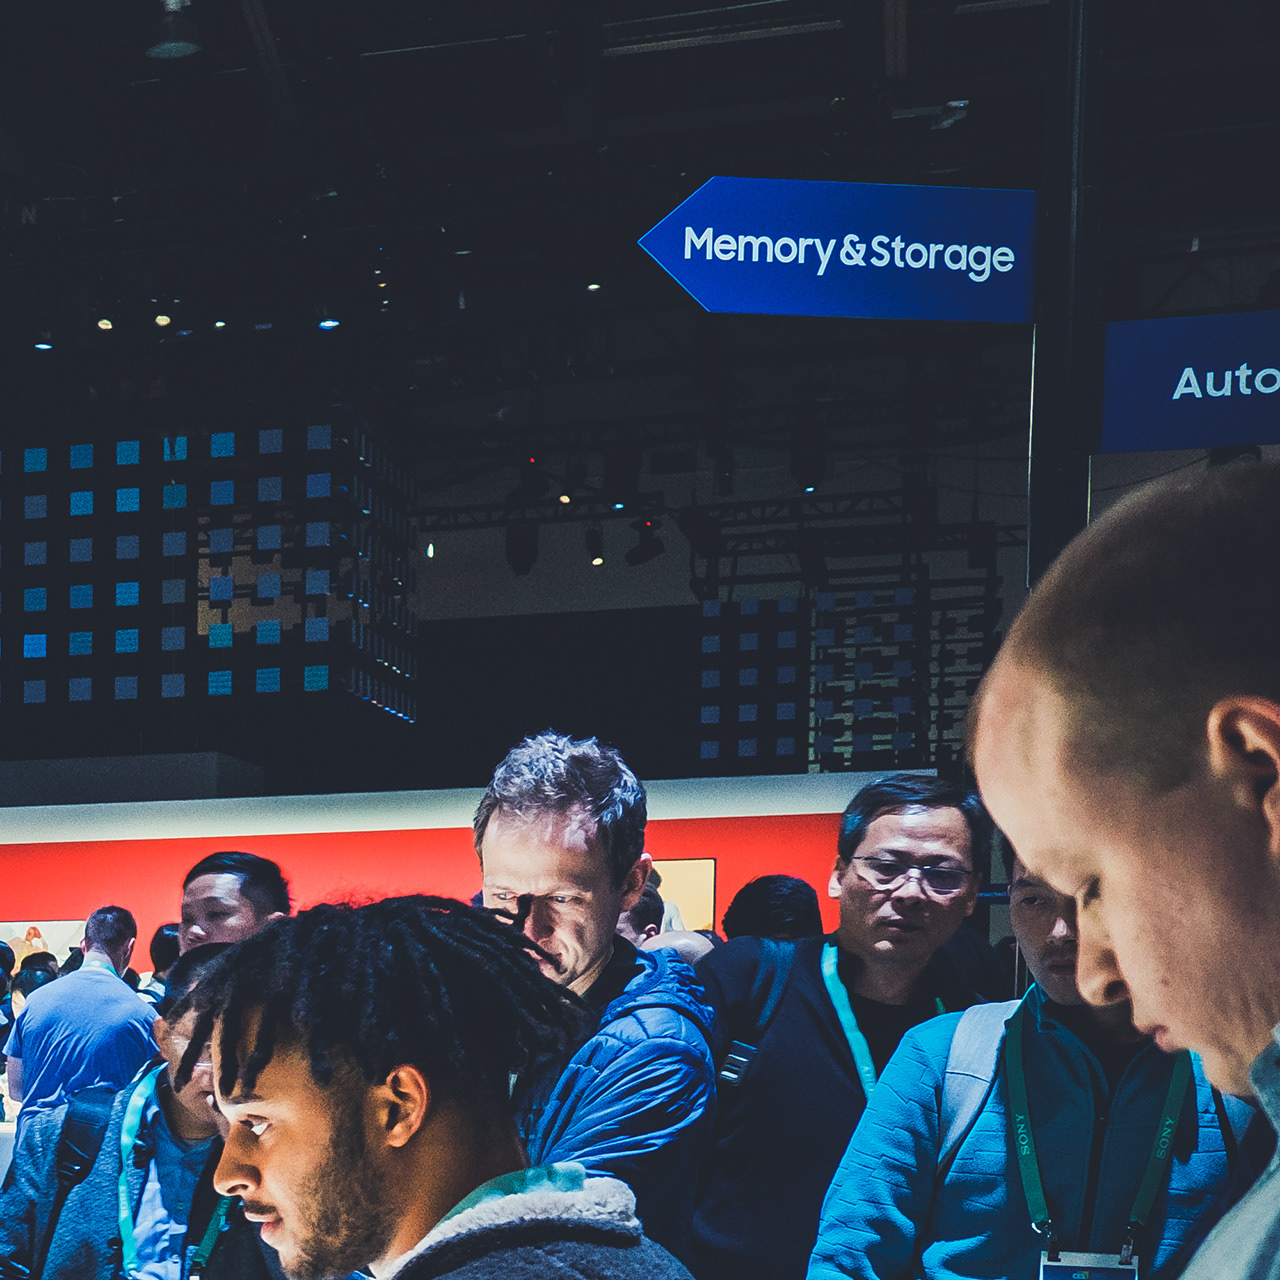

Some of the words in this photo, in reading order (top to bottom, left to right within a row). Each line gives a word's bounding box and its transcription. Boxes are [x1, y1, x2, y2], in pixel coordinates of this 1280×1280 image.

[1172, 363, 1280, 401] Auto
[1015, 1113, 1031, 1156] SONY
[1156, 1116, 1175, 1160] SONY
